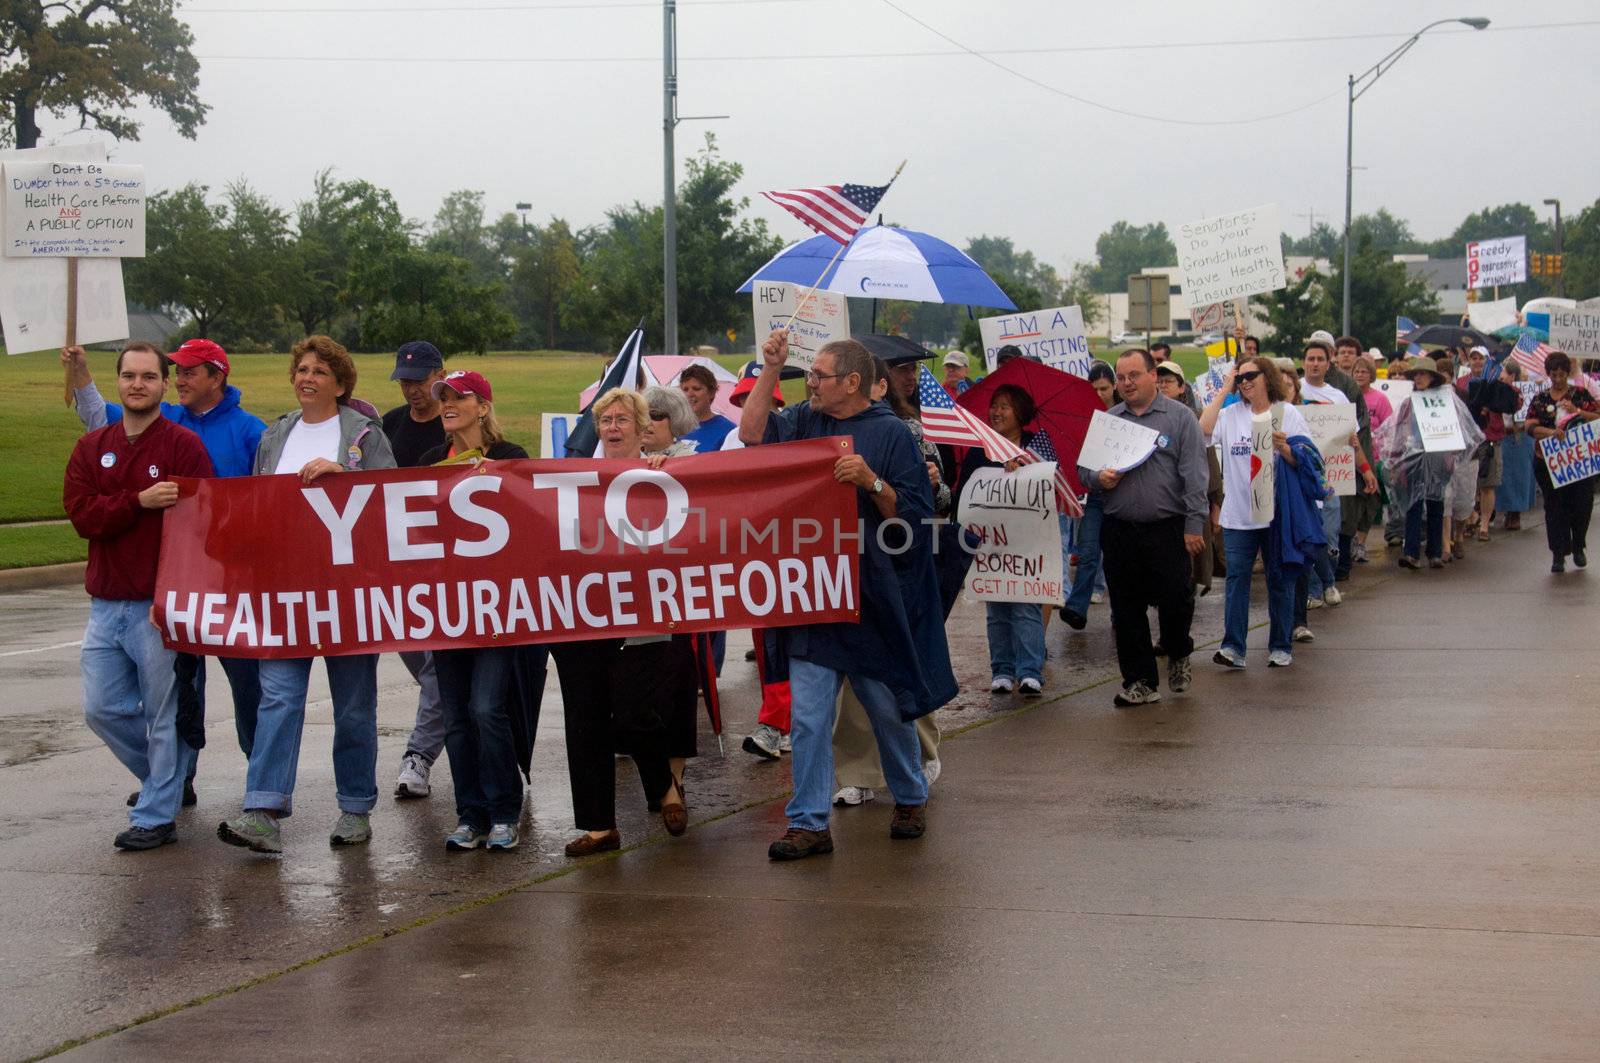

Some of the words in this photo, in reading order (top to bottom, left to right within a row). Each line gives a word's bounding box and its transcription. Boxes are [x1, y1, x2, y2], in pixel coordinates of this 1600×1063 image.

[87, 164, 102, 174] Be
[13, 178, 51, 190] Dumber
[56, 179, 80, 188] than
[112, 180, 141, 188] Grader
[25, 193, 66, 208] Health
[70, 194, 98, 208] Care
[102, 194, 141, 206] Reform
[60, 207, 81, 217] AND
[26, 220, 35, 231] A
[40, 218, 81, 230] PUBLIC
[86, 218, 133, 229] OPTION
[1182, 212, 1256, 239] Senators:
[32, 246, 70, 254] AMERICAN
[1191, 240, 1208, 250] Do
[1219, 228, 1251, 244] your
[1184, 244, 1269, 271] Grandchildren
[1186, 272, 1220, 288] have
[1230, 258, 1274, 278] Health
[760, 287, 785, 303] HEY
[1191, 268, 1281, 304] Insurance?
[997, 315, 1038, 337] I'M
[1051, 311, 1068, 329] A
[1554, 313, 1600, 328] HEALTH
[1578, 329, 1598, 339] NOT
[1097, 416, 1158, 441] HEALTH
[1541, 423, 1595, 457] HEALTH
[1548, 444, 1584, 472] CARE
[970, 478, 1017, 505] MAN
[301, 475, 510, 566] YES
[533, 468, 690, 551] TO
[974, 552, 1044, 581] BOREN!
[165, 589, 342, 647] HEALTH
[354, 571, 638, 642] INSURANCE
[648, 554, 855, 623] REFORM
[971, 578, 1001, 594] GET
[1006, 580, 1018, 596] IT
[1024, 581, 1061, 600] DONE!
